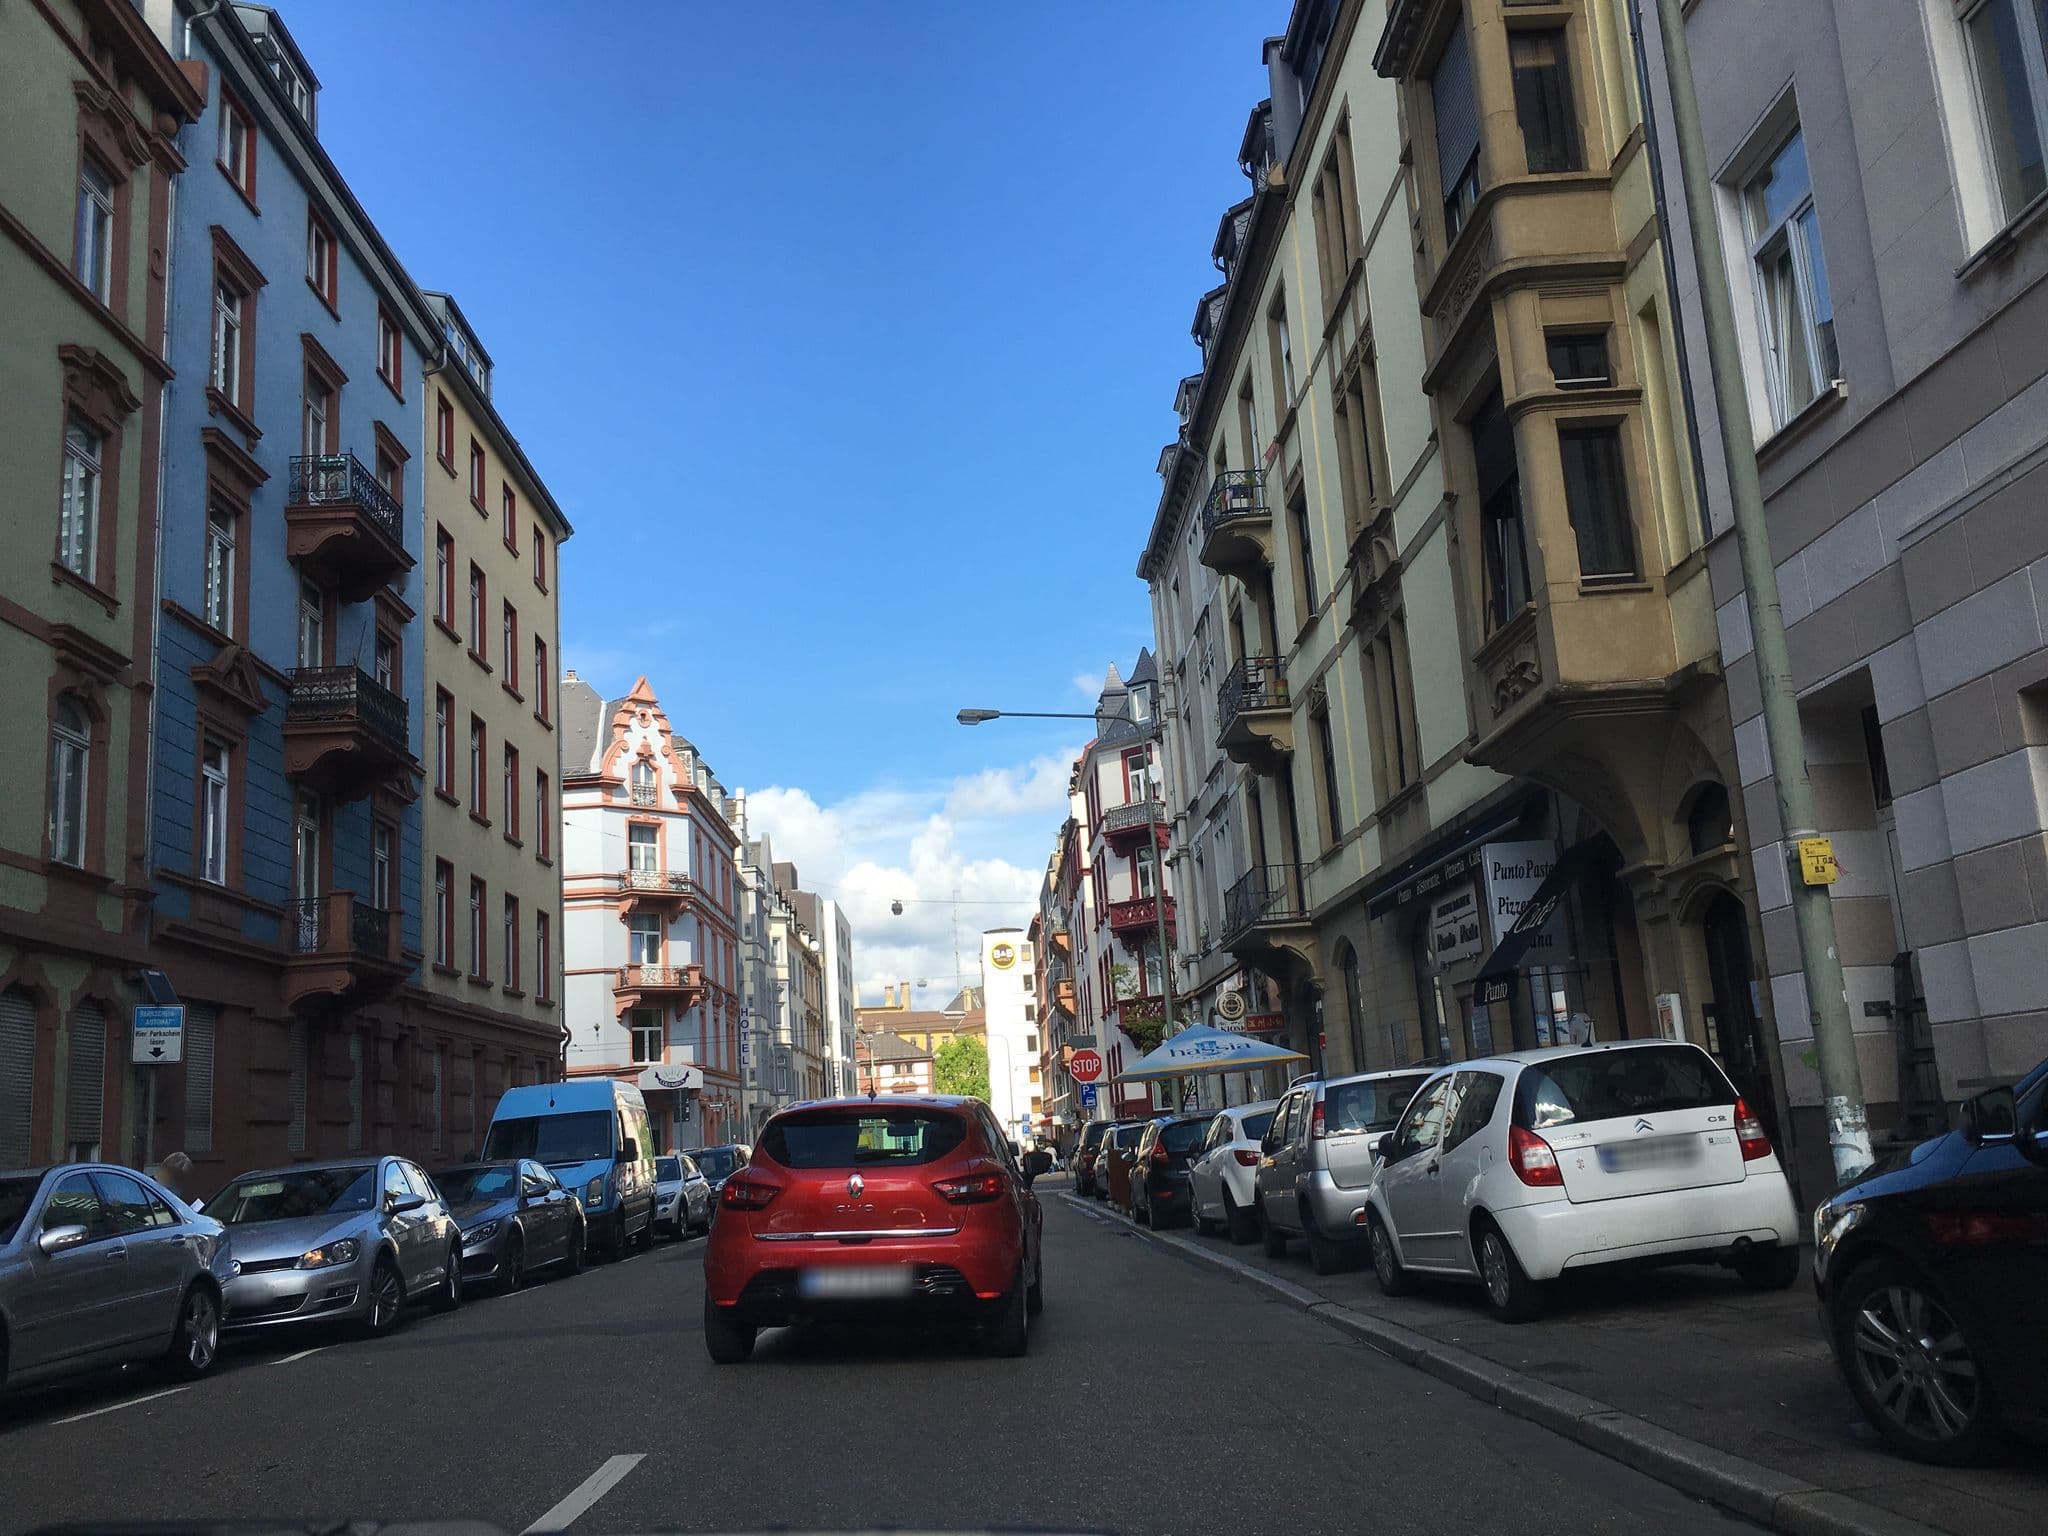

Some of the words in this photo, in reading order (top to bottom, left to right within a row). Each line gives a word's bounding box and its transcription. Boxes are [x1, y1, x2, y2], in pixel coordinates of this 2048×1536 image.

[1493, 861, 1525, 881] Punto
[1498, 896, 1530, 915] Pizze
[1485, 982, 1508, 1002] Punto
[150, 1029, 180, 1037] Parkschein
[740, 1008, 749, 1065] HOTEL
[1169, 1041, 1252, 1058] hassia
[1073, 1058, 1100, 1073] STOP
[1082, 1085, 1090, 1096] P
[1707, 1115, 1728, 1123] C2
